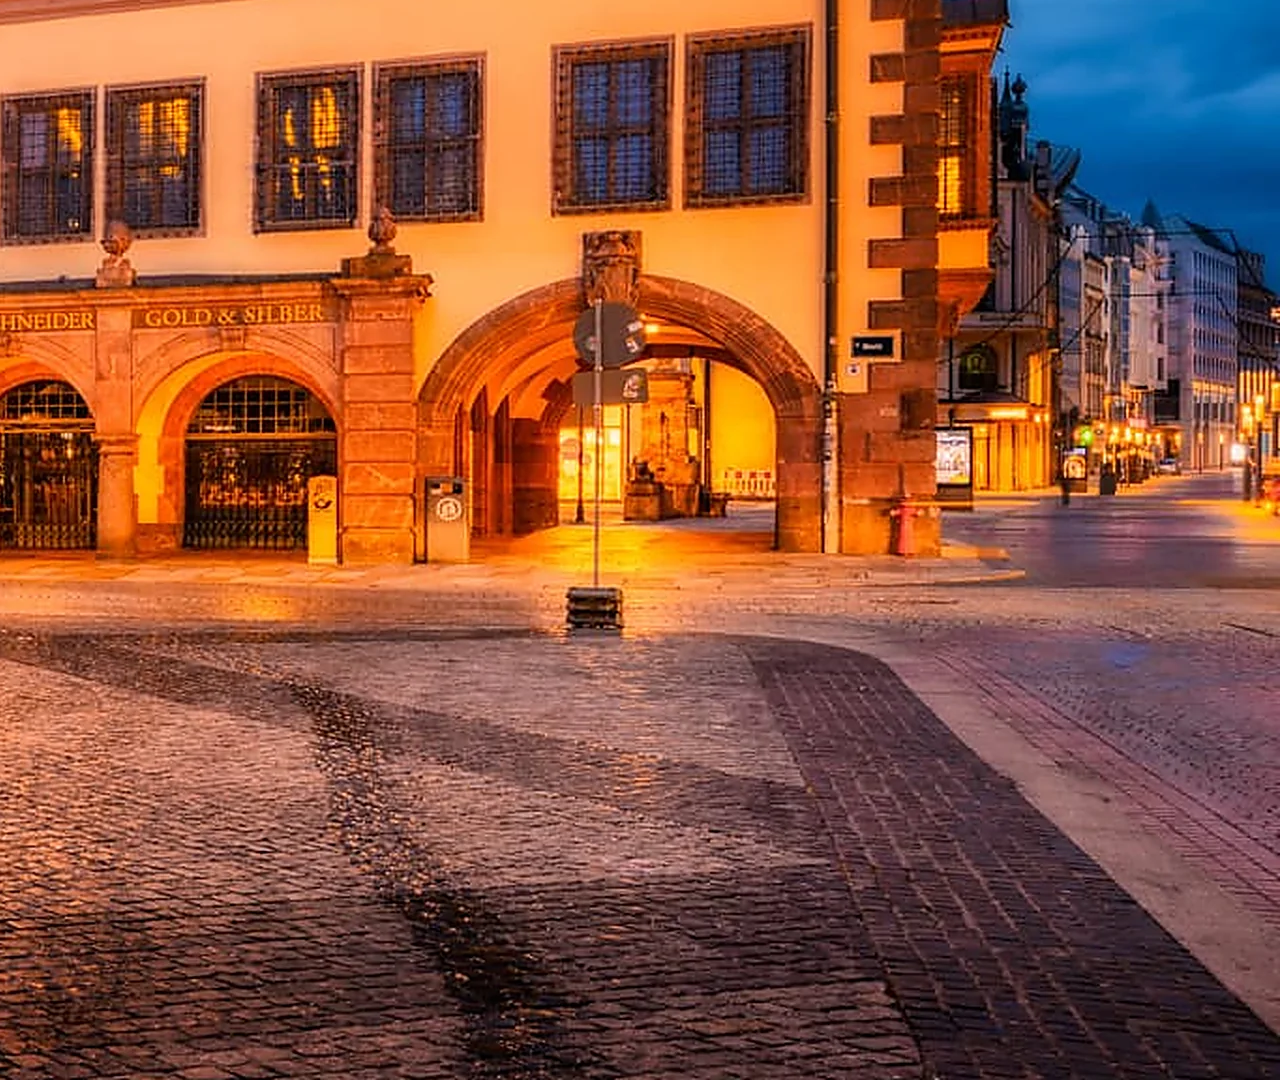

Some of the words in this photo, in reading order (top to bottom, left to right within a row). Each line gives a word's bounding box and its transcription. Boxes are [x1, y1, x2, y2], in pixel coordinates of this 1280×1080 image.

[145, 308, 213, 327] GOLD
[217, 308, 235, 325] &
[244, 304, 324, 324] SILBER
